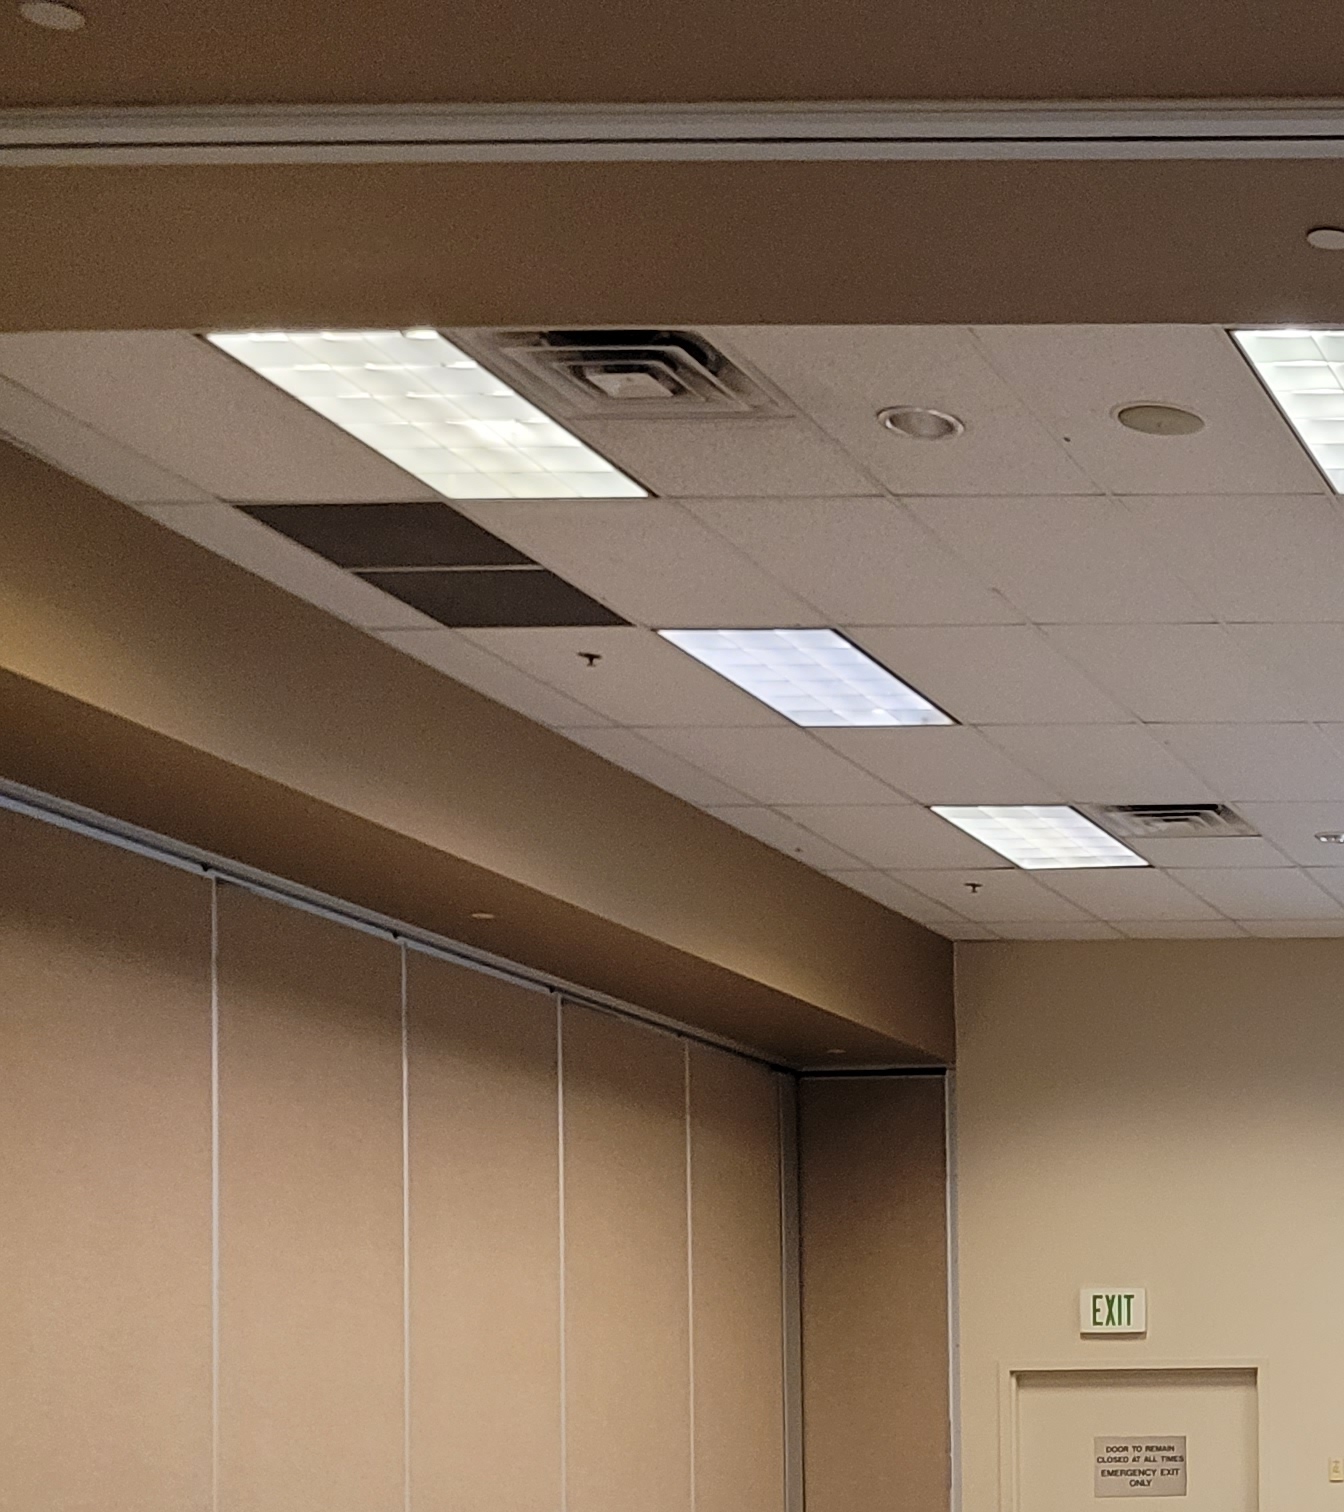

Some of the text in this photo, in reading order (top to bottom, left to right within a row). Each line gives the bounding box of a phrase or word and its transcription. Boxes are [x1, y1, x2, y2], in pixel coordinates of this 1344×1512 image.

[1092, 1294, 1135, 1326] EXIT
[1101, 1468, 1180, 1477] EMERGENCY EXIT
[1129, 1479, 1152, 1487] ONLY
